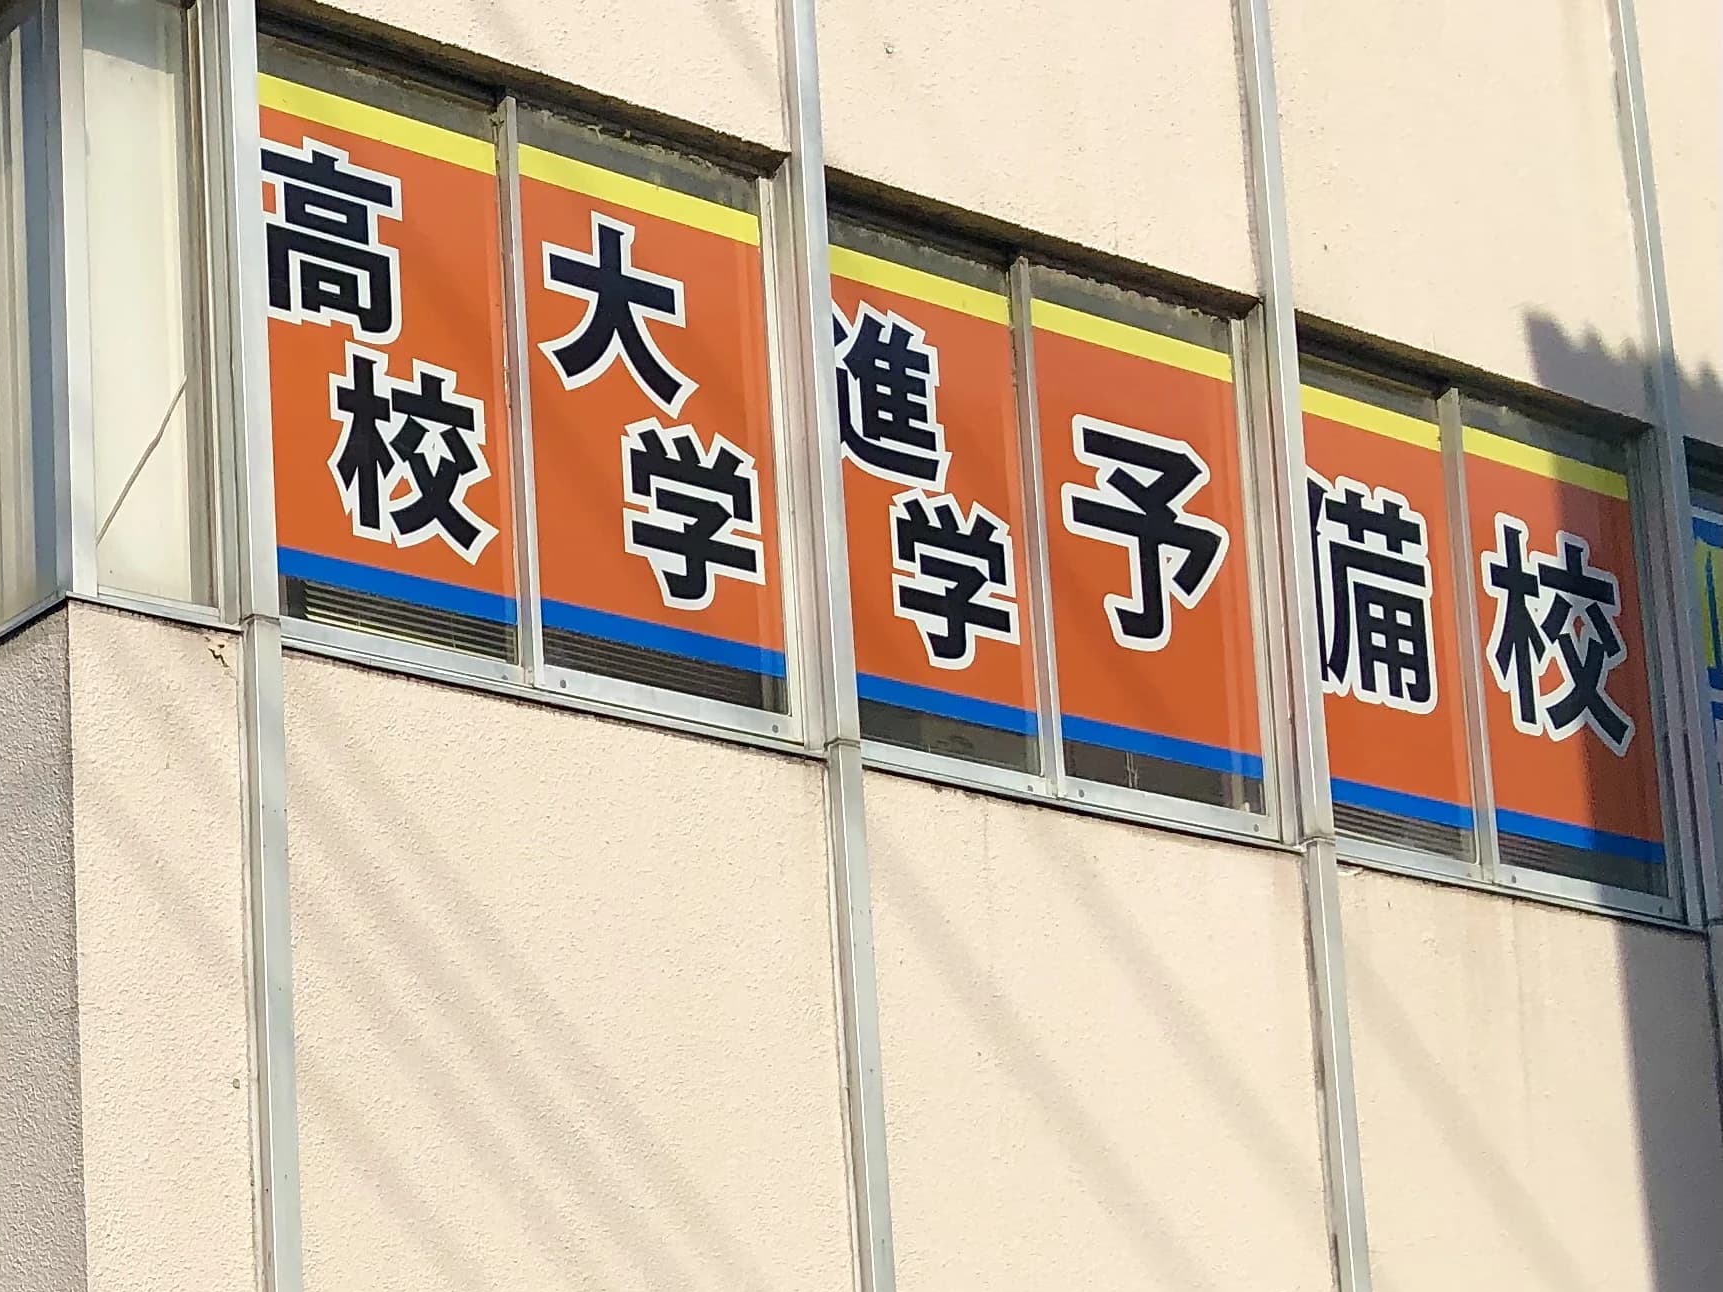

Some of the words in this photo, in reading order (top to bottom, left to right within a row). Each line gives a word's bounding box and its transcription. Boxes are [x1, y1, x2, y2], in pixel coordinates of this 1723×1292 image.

[260, 137, 498, 564] 高校
[536, 210, 766, 611] 大学
[831, 300, 1020, 671] 進学
